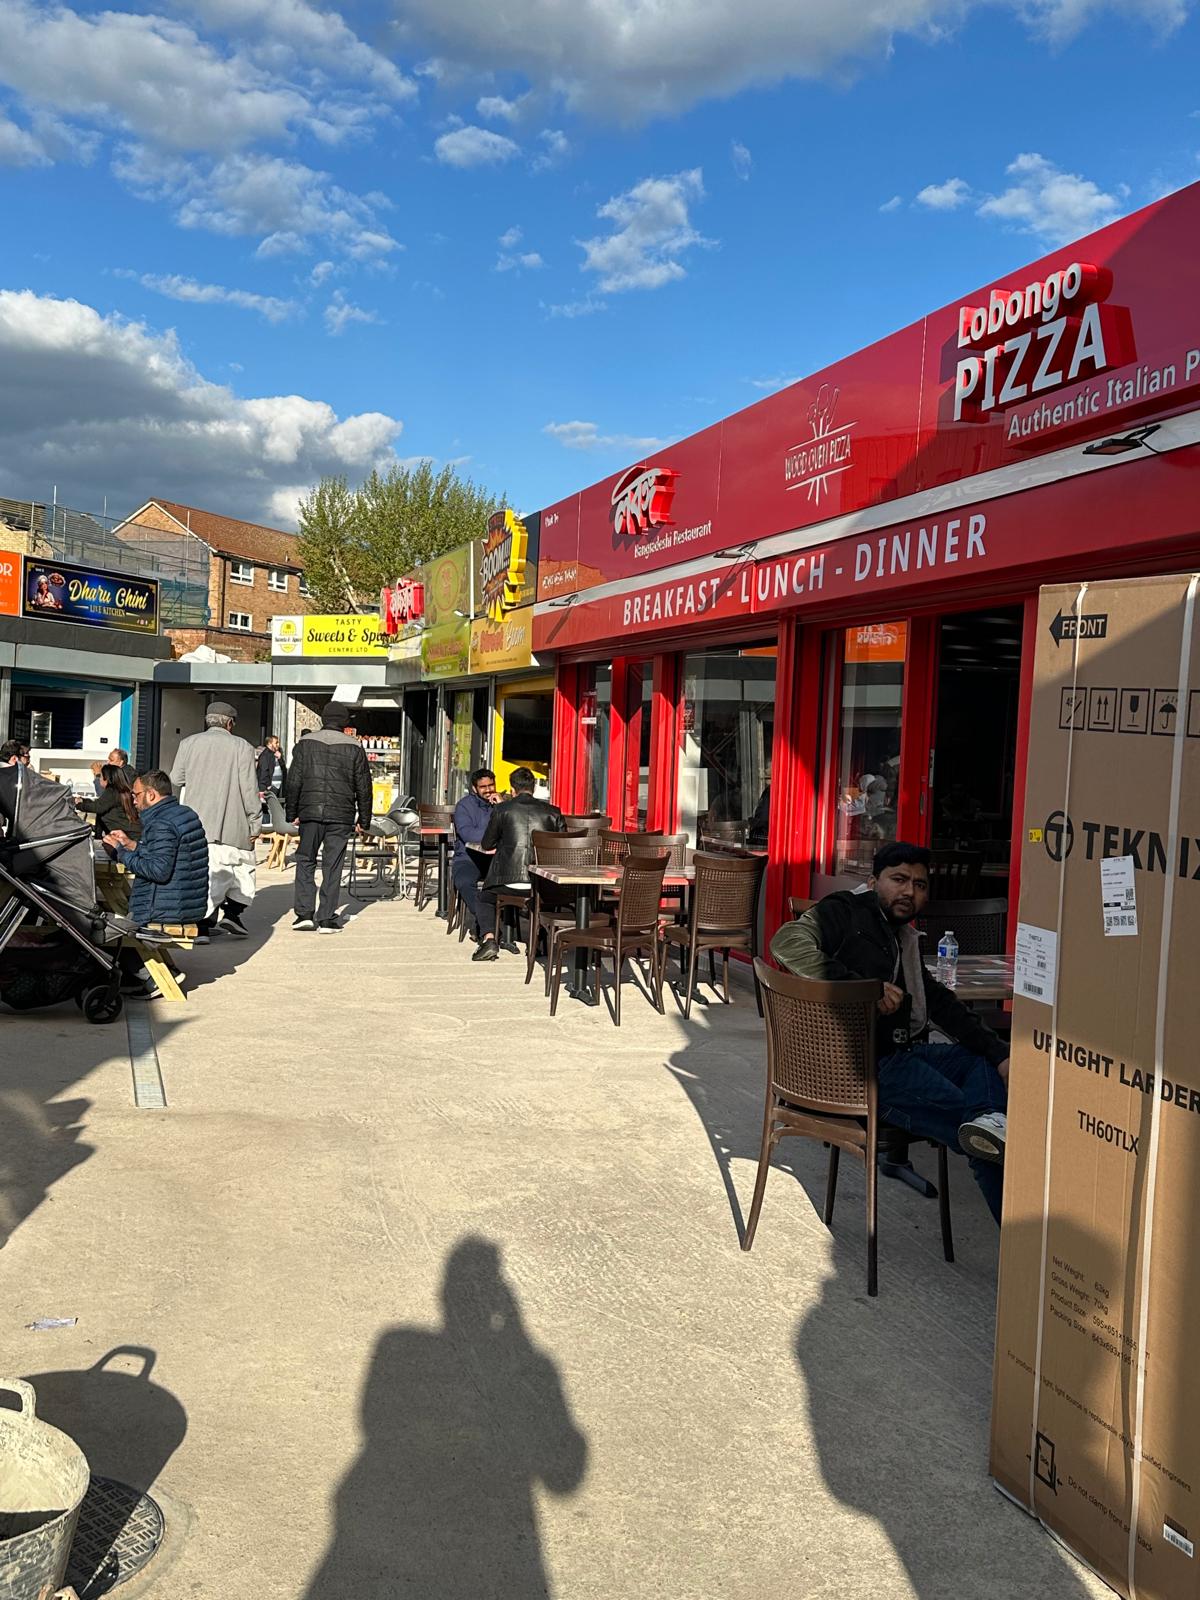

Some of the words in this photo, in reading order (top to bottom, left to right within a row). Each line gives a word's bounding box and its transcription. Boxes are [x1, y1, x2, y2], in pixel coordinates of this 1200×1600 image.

[957, 262, 1082, 349] Lobongo
[952, 302, 1107, 422] PIZZA
[1007, 387, 1100, 441] Authentic
[1106, 365, 1176, 408] Italian
[785, 451, 808, 480] WOOD
[808, 442, 829, 472] OVEN
[830, 434, 851, 464] PIZZA
[673, 519, 712, 547] Restaurant
[0, 562, 13, 577] R
[623, 577, 721, 626] BREAKFAST
[740, 553, 826, 604] LUNCH
[855, 513, 987, 582] DINNER
[68, 579, 112, 604] Dharu
[115, 588, 149, 610] Chini
[307, 628, 345, 643] Sweets
[347, 628, 358, 643] &
[335, 618, 362, 626] TASTY
[1061, 618, 1105, 637] FRONT
[1033, 1028, 1114, 1078] UPRIGHT
[1119, 1062, 1200, 1115] LARDER
[1077, 1109, 1139, 1156] TH60TLX
[1068, 1476, 1078, 1490] Do
[1077, 1486, 1089, 1498] not
[1088, 1495, 1108, 1515] clamp
